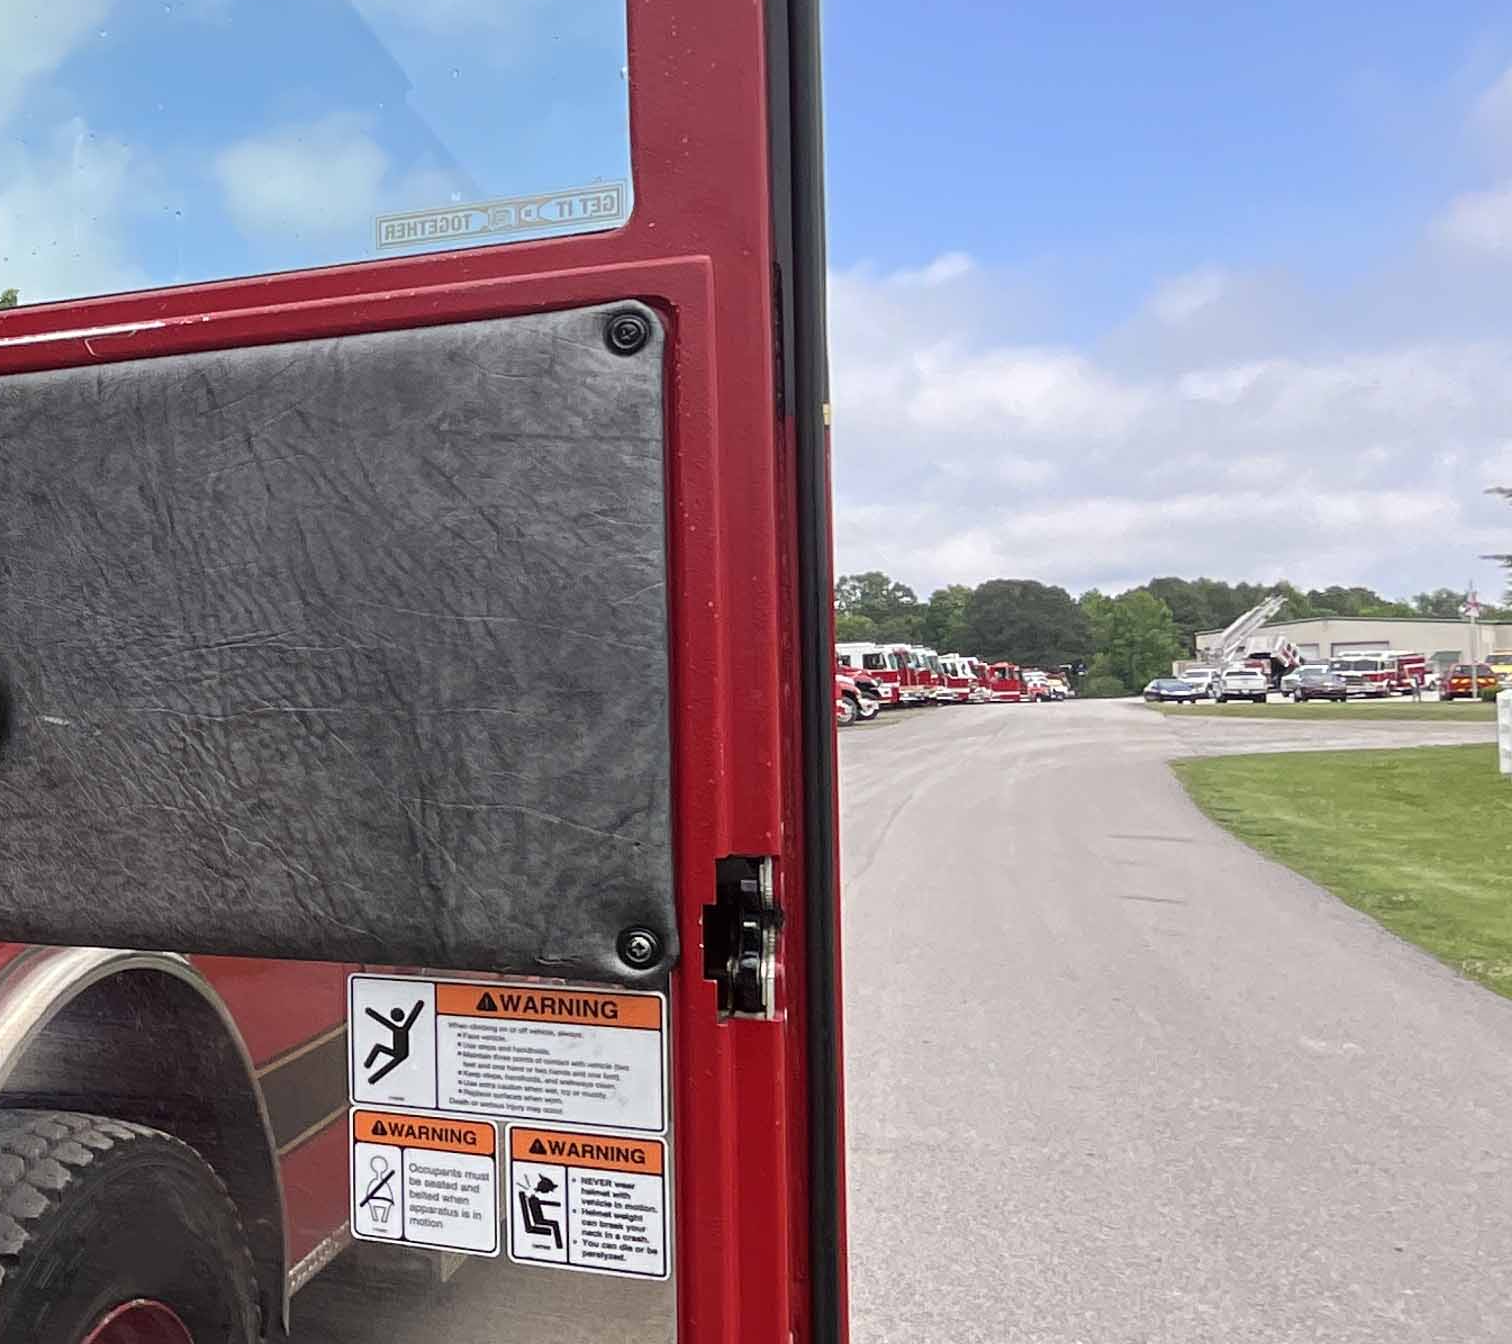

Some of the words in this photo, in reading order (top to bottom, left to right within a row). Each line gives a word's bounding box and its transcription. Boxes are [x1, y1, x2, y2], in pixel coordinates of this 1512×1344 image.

[500, 994, 619, 1020] WARNING
[389, 1121, 477, 1146] WARNING
[548, 1139, 647, 1165] WARNING
[409, 1163, 462, 1178] Occupants
[464, 1170, 489, 1181] must
[409, 1177, 421, 1186] be
[424, 1179, 457, 1190] seated
[460, 1185, 480, 1193] and
[581, 1177, 612, 1187] NEVER
[409, 1190, 439, 1201] belted
[442, 1194, 469, 1205] when
[581, 1188, 610, 1197] helmet
[581, 1198, 612, 1207] vehicle
[614, 1201, 622, 1209] in
[409, 1204, 458, 1218] apparatus
[462, 1210, 470, 1218] is
[473, 1211, 482, 1220] in
[581, 1208, 611, 1218] Helmet
[614, 1213, 643, 1223] weight
[581, 1229, 602, 1237] neck
[605, 1231, 613, 1239] in
[599, 1220, 623, 1230] break
[626, 1225, 646, 1233] your
[582, 1239, 599, 1248] You
[620, 1243, 633, 1252] die
[647, 1247, 658, 1255] be
